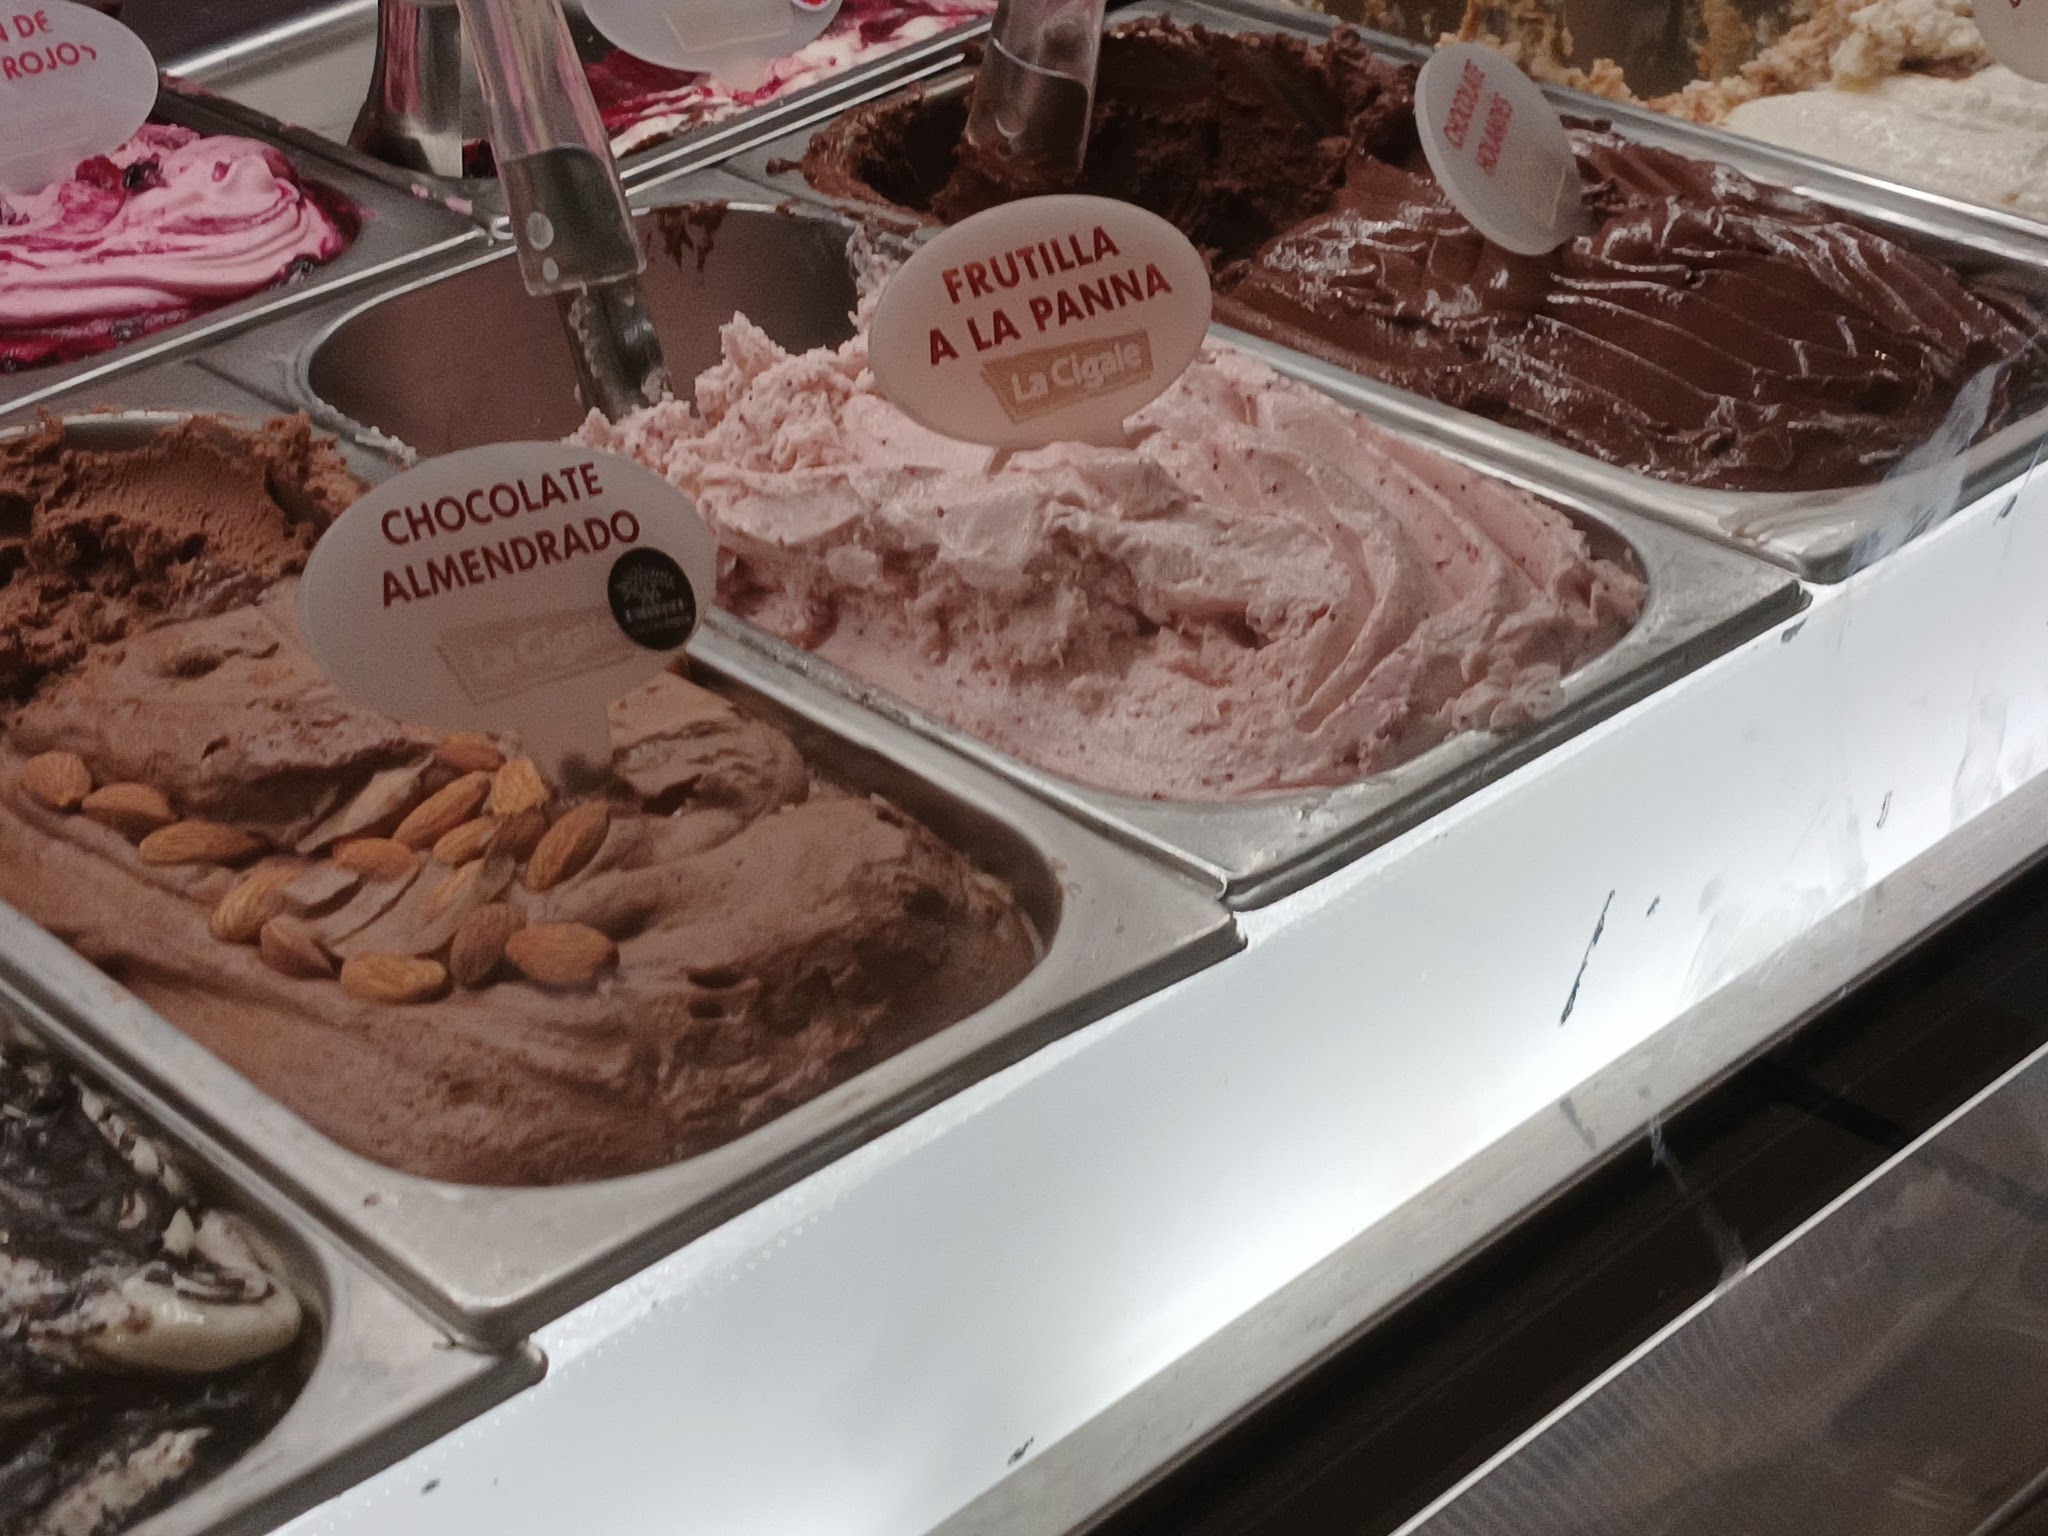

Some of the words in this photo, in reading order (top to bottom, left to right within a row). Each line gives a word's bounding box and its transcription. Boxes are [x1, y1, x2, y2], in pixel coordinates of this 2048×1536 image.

[12, 10, 53, 38] DE
[942, 225, 1120, 304] FRUTILLA
[929, 327, 959, 366] A
[967, 308, 1021, 351] LA
[1029, 262, 1173, 333] PANNA
[380, 462, 603, 547] CHOCOLATE
[383, 509, 640, 607] ALMENDRADO
